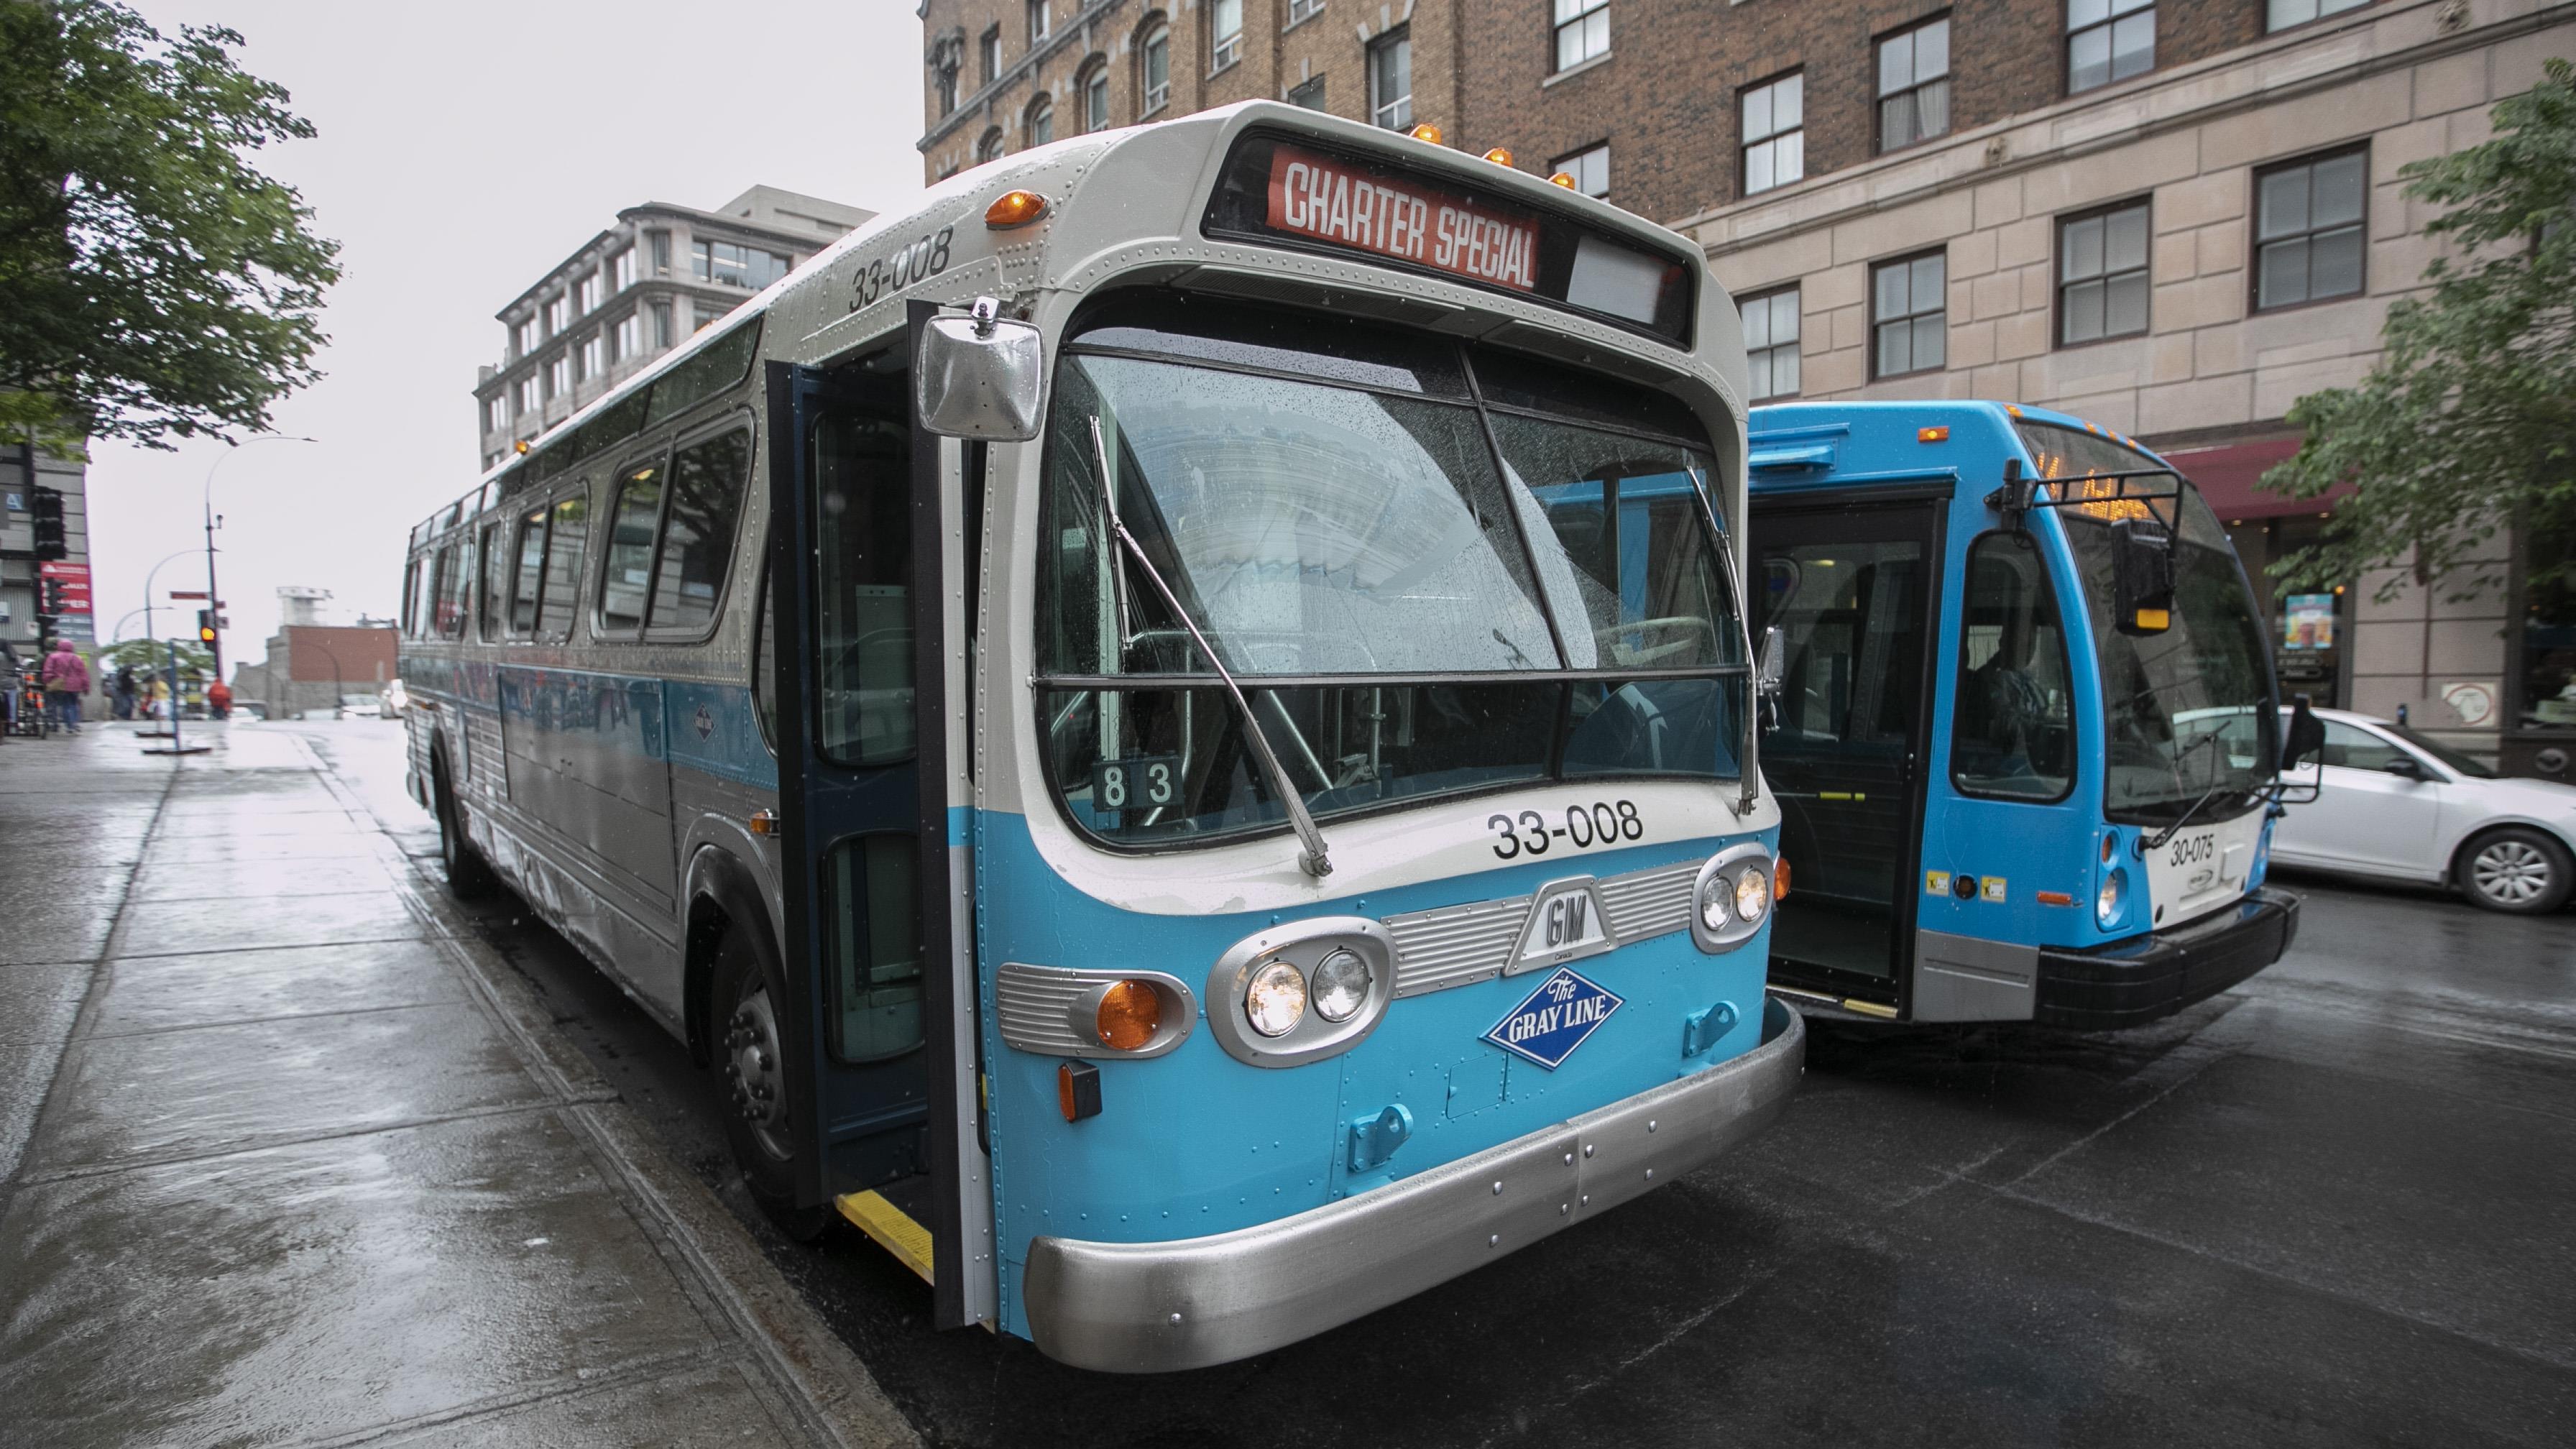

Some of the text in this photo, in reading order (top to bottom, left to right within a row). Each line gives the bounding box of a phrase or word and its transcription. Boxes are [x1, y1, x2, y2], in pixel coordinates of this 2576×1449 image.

[1284, 162, 1535, 288] CHARTER SPECIAL
[849, 224, 954, 313] 33-008
[1487, 799, 1643, 860] 33-008
[2171, 833, 2214, 867] 30-075
[1546, 894, 1587, 947] GM
[1547, 975, 1576, 1003] The
[1509, 994, 1606, 1043] GRAY LINE
